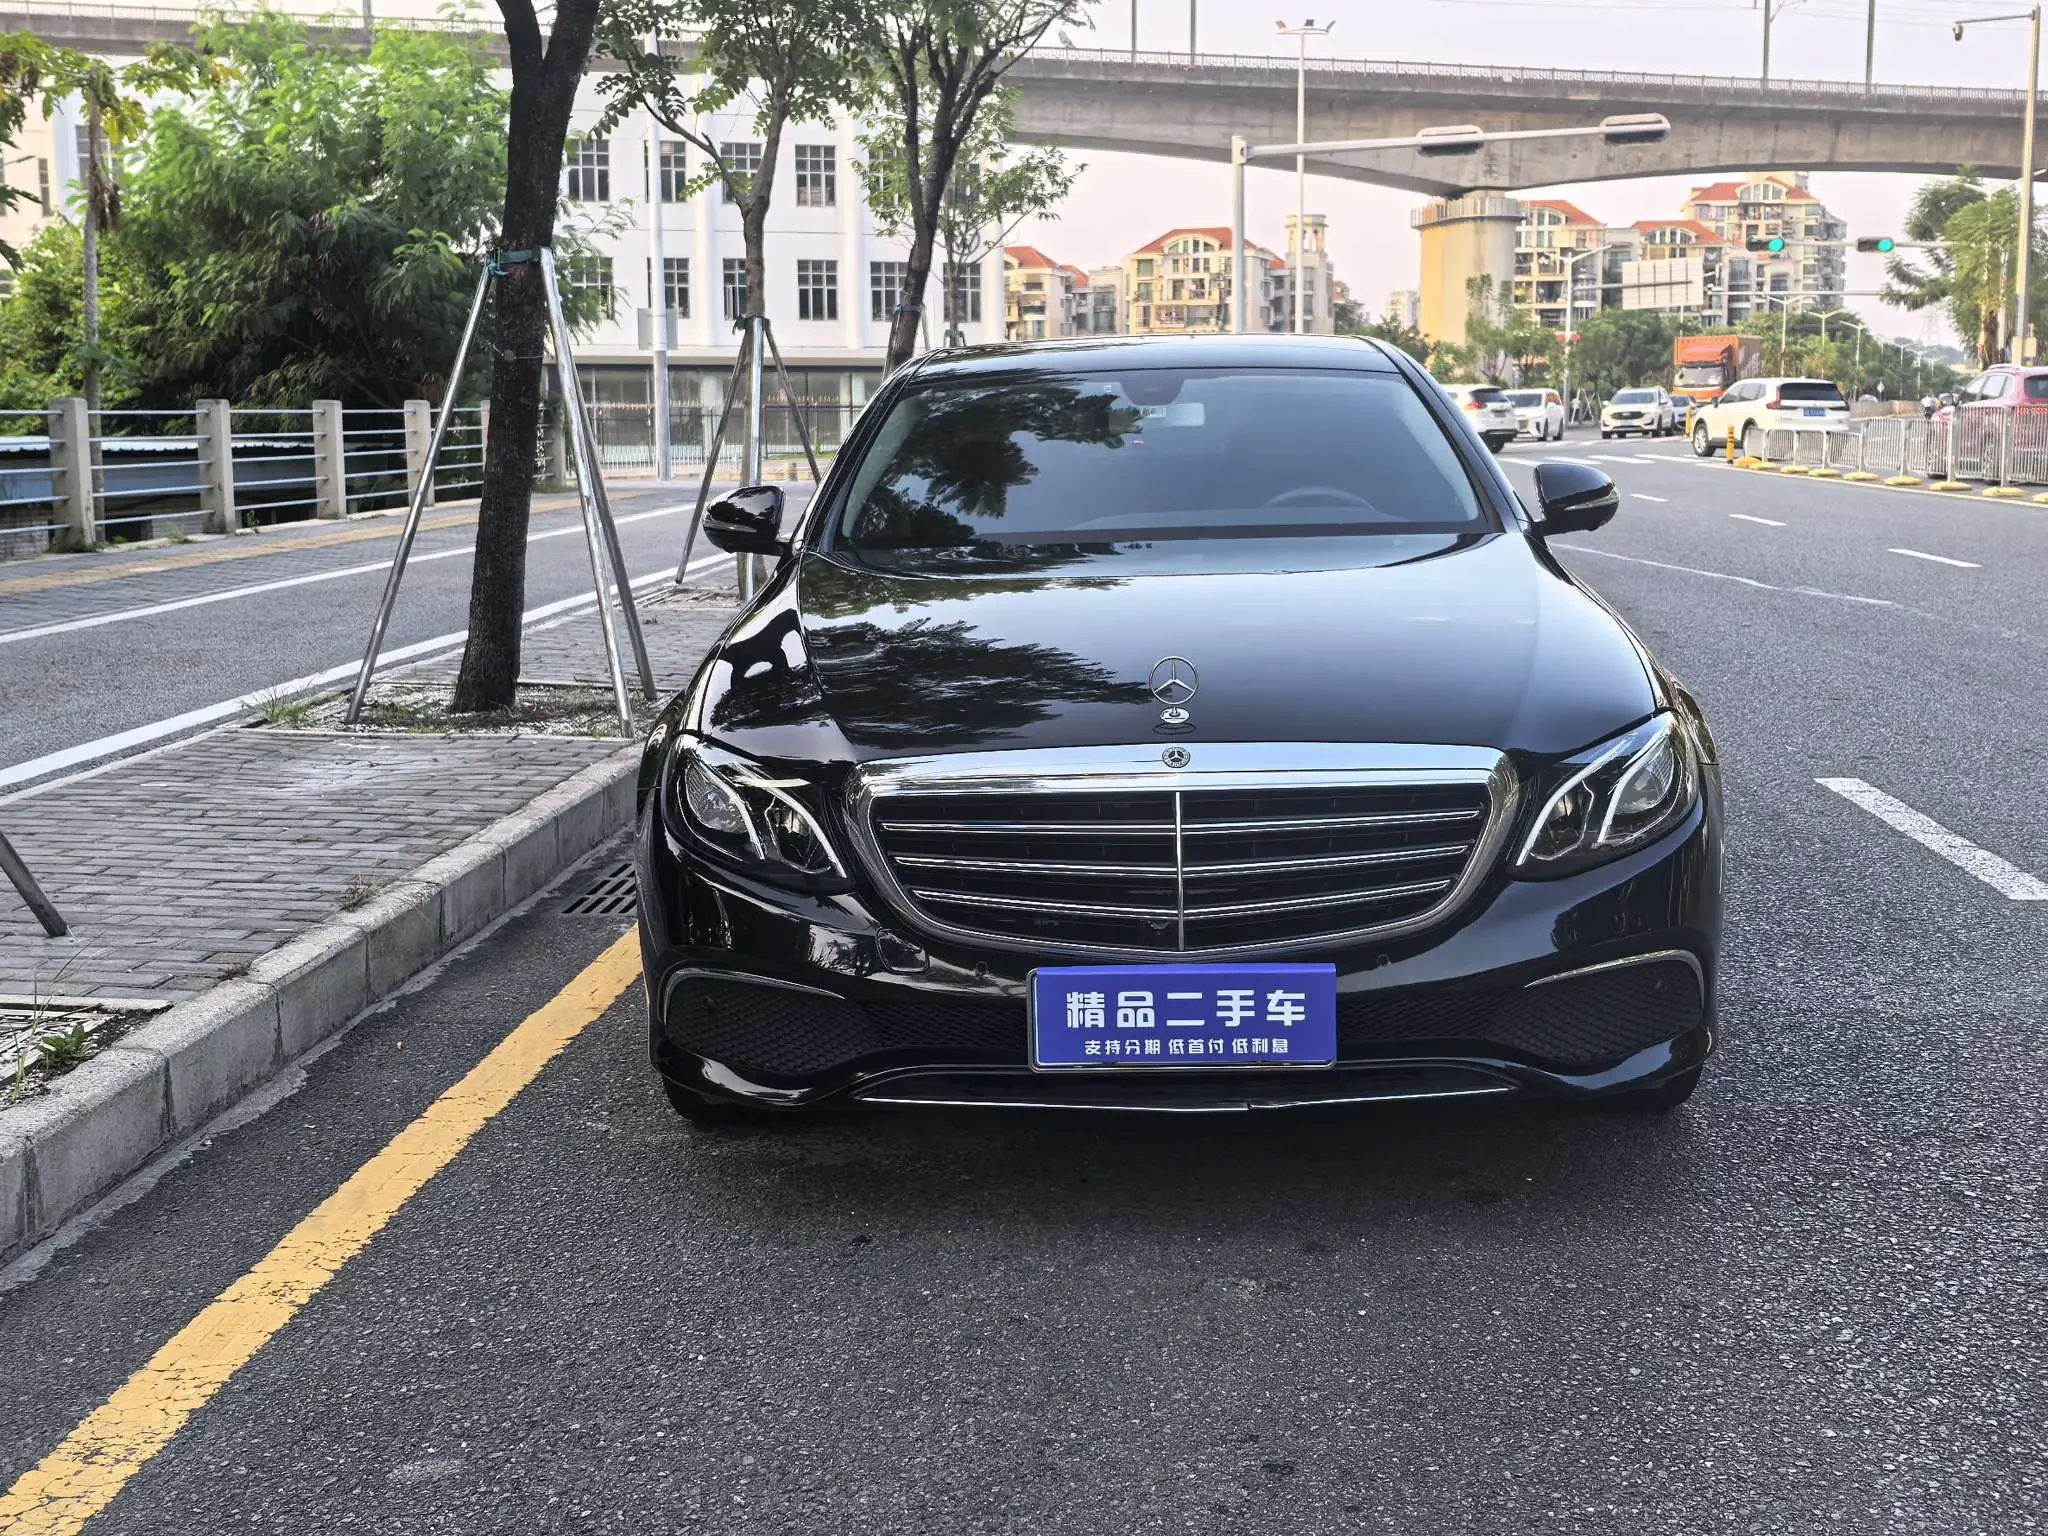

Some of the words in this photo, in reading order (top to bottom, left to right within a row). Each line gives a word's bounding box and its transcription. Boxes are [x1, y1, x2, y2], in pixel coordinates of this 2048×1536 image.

[1066, 989, 1306, 1029] 精品二手车
[1084, 1039, 1161, 1055] 支持分期
[1168, 1038, 1224, 1055] 低首付
[1231, 1037, 1289, 1054] 低利息
